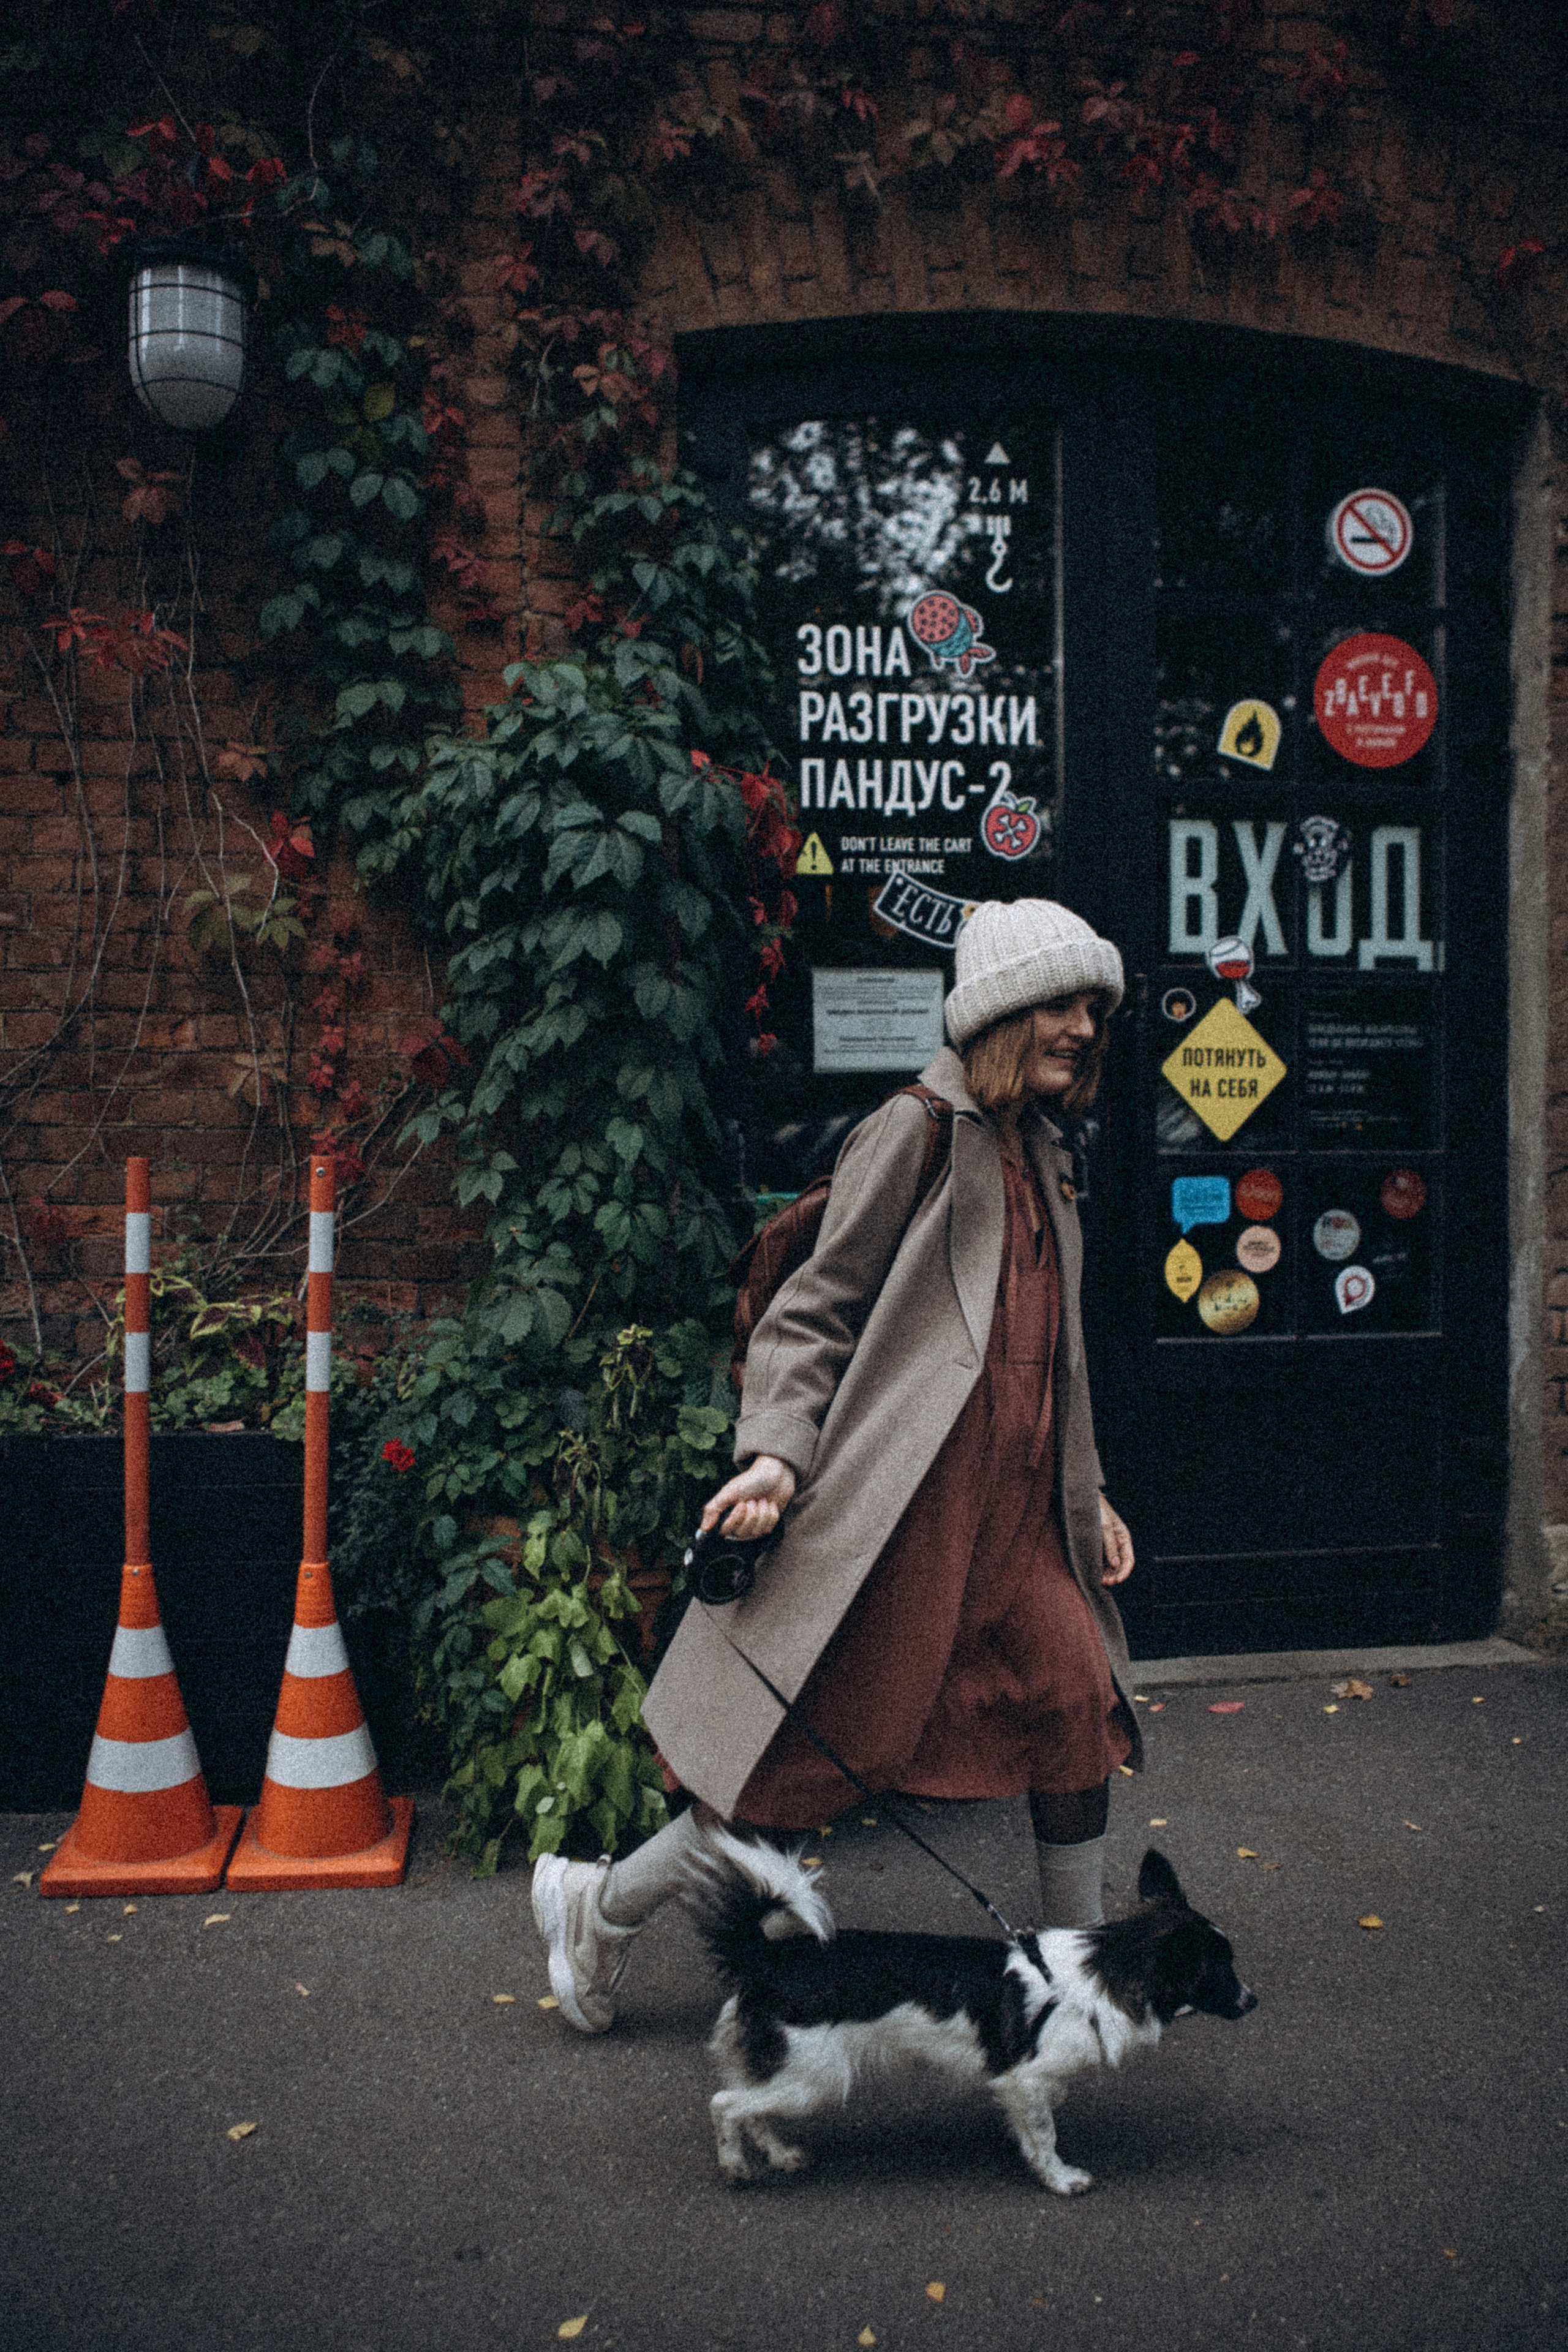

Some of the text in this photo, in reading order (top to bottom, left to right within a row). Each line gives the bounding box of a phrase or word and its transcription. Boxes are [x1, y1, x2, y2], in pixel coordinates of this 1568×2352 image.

[798, 624, 911, 677] ЗОНА
[800, 691, 1037, 747] РАЗГРУЗКИ
[801, 758, 1013, 817] ПАНДУС-2
[841, 837, 973, 853] DON'T LEAVE THE CART
[841, 859, 945, 874] AT THE ENTRANCE
[891, 884, 956, 936] ЕСТЬ
[1183, 1048, 1267, 1068] ПОТЯНУТЬ
[1190, 1079, 1258, 1098] НА СЕБЯ
